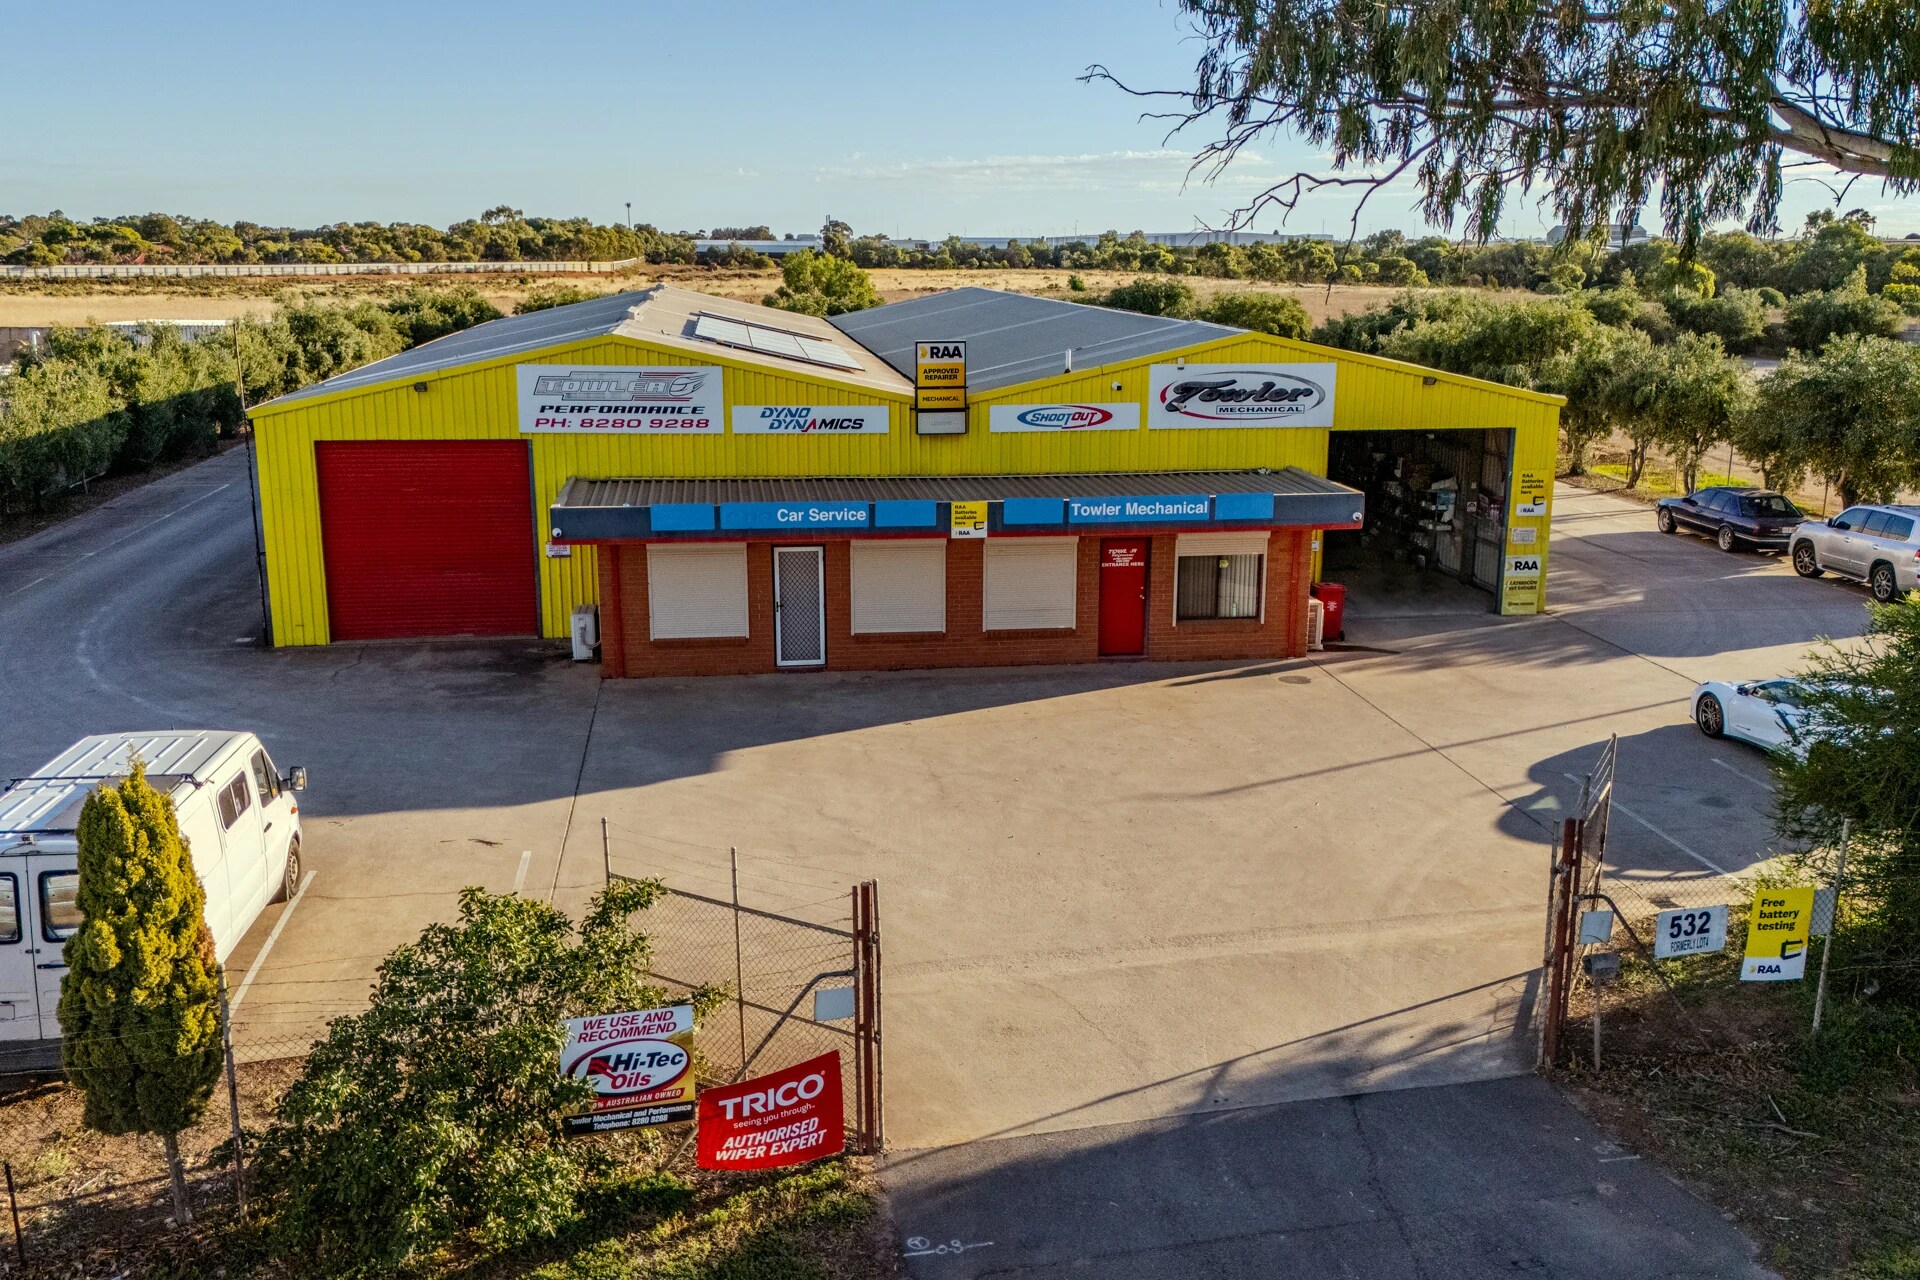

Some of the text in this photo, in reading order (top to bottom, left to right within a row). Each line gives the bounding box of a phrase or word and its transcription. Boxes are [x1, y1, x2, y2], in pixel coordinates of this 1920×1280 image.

[930, 346, 962, 358] RAA
[542, 379, 667, 394] TOWLER
[1165, 379, 1314, 412] Towler
[539, 404, 706, 415] PERFORMANCE
[760, 407, 811, 418] DYNO
[535, 418, 710, 428] PH: 8280 9288
[768, 418, 864, 432] DYNAMICS
[777, 507, 866, 522] Car Service
[1071, 501, 1208, 516] Towler Mechanical
[1514, 561, 1538, 571] RAA
[1761, 898, 1785, 908] Free
[1759, 909, 1800, 920] battery
[1669, 911, 1712, 939] 532
[1757, 921, 1796, 932] testing
[1670, 940, 1696, 953] FORMERLY
[1757, 964, 1782, 975] RAA
[583, 1010, 674, 1031] WE USE AND
[577, 1021, 677, 1043] RECOMMEND
[611, 1051, 684, 1073] Hi-Tec
[610, 1072, 652, 1090] Oils
[606, 1094, 652, 1107] AUSTRALIAN
[654, 1089, 682, 1099] OWNED
[718, 1074, 825, 1120] TRICO
[592, 1110, 633, 1123] Mechanical
[633, 1107, 647, 1117] and
[647, 1104, 692, 1116] Performance
[733, 1102, 812, 1129] seeing you through
[593, 1119, 631, 1130] Telephone:
[631, 1116, 650, 1126] 8280
[722, 1117, 819, 1150] AUTHORISED
[715, 1129, 828, 1161] WIPER EXPERT
